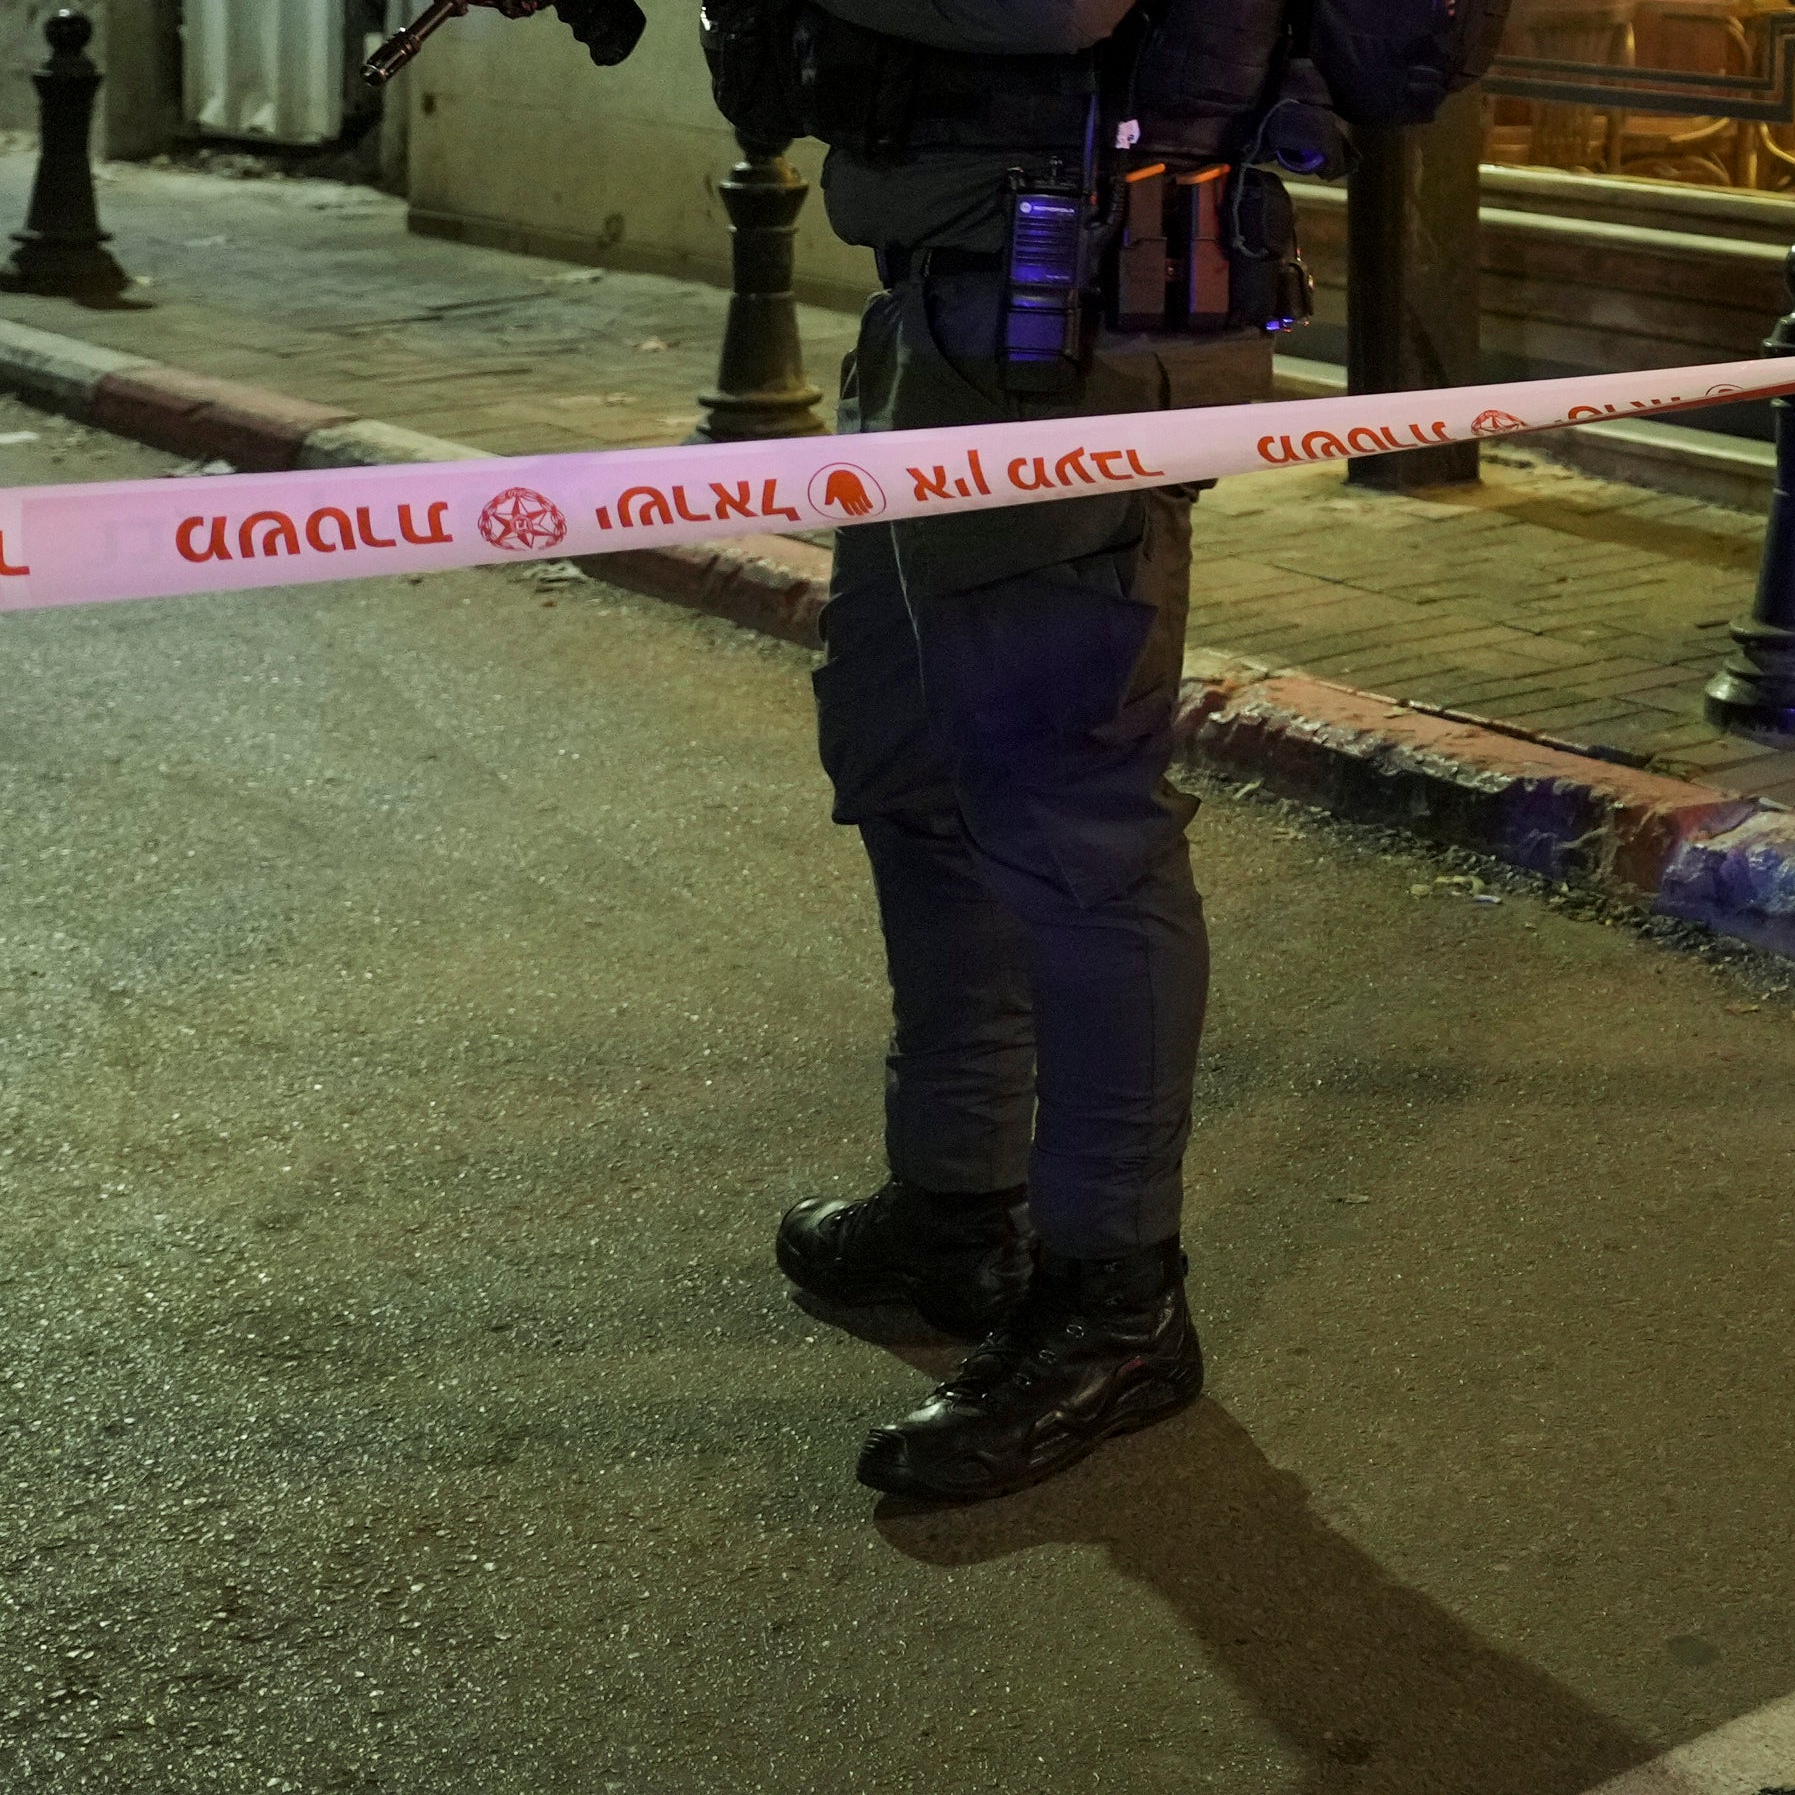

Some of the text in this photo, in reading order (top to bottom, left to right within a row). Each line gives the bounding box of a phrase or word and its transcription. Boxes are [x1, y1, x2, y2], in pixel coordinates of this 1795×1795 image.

[174, 446, 1166, 565] משטרת ישראל אין מעבר
